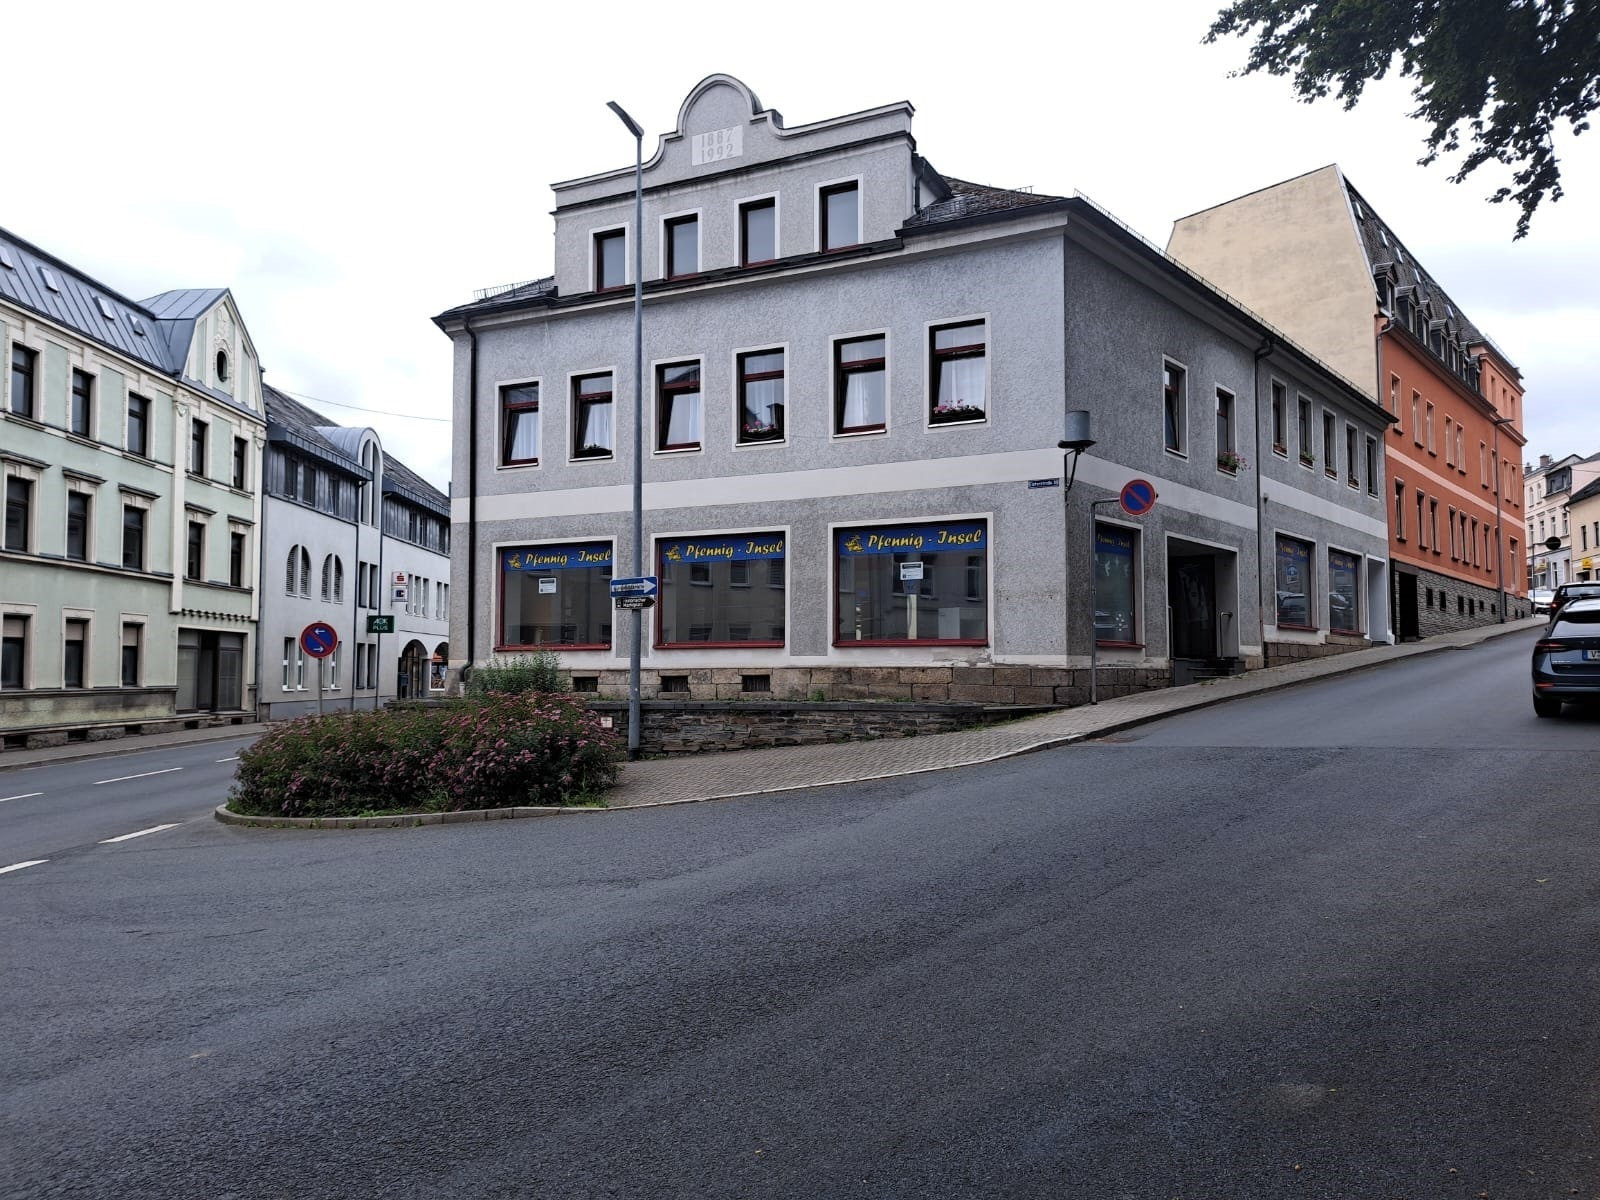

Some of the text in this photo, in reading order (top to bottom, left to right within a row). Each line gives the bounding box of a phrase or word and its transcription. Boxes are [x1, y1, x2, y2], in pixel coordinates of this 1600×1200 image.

[701, 127, 734, 148] 1887
[701, 143, 733, 163] 1992
[868, 533, 923, 550] Pfennig
[937, 529, 982, 545] Insel
[525, 552, 568, 568] Pfennig
[578, 549, 611, 562] Insel
[686, 543, 734, 560] Pfennig
[745, 540, 783, 555] Insel
